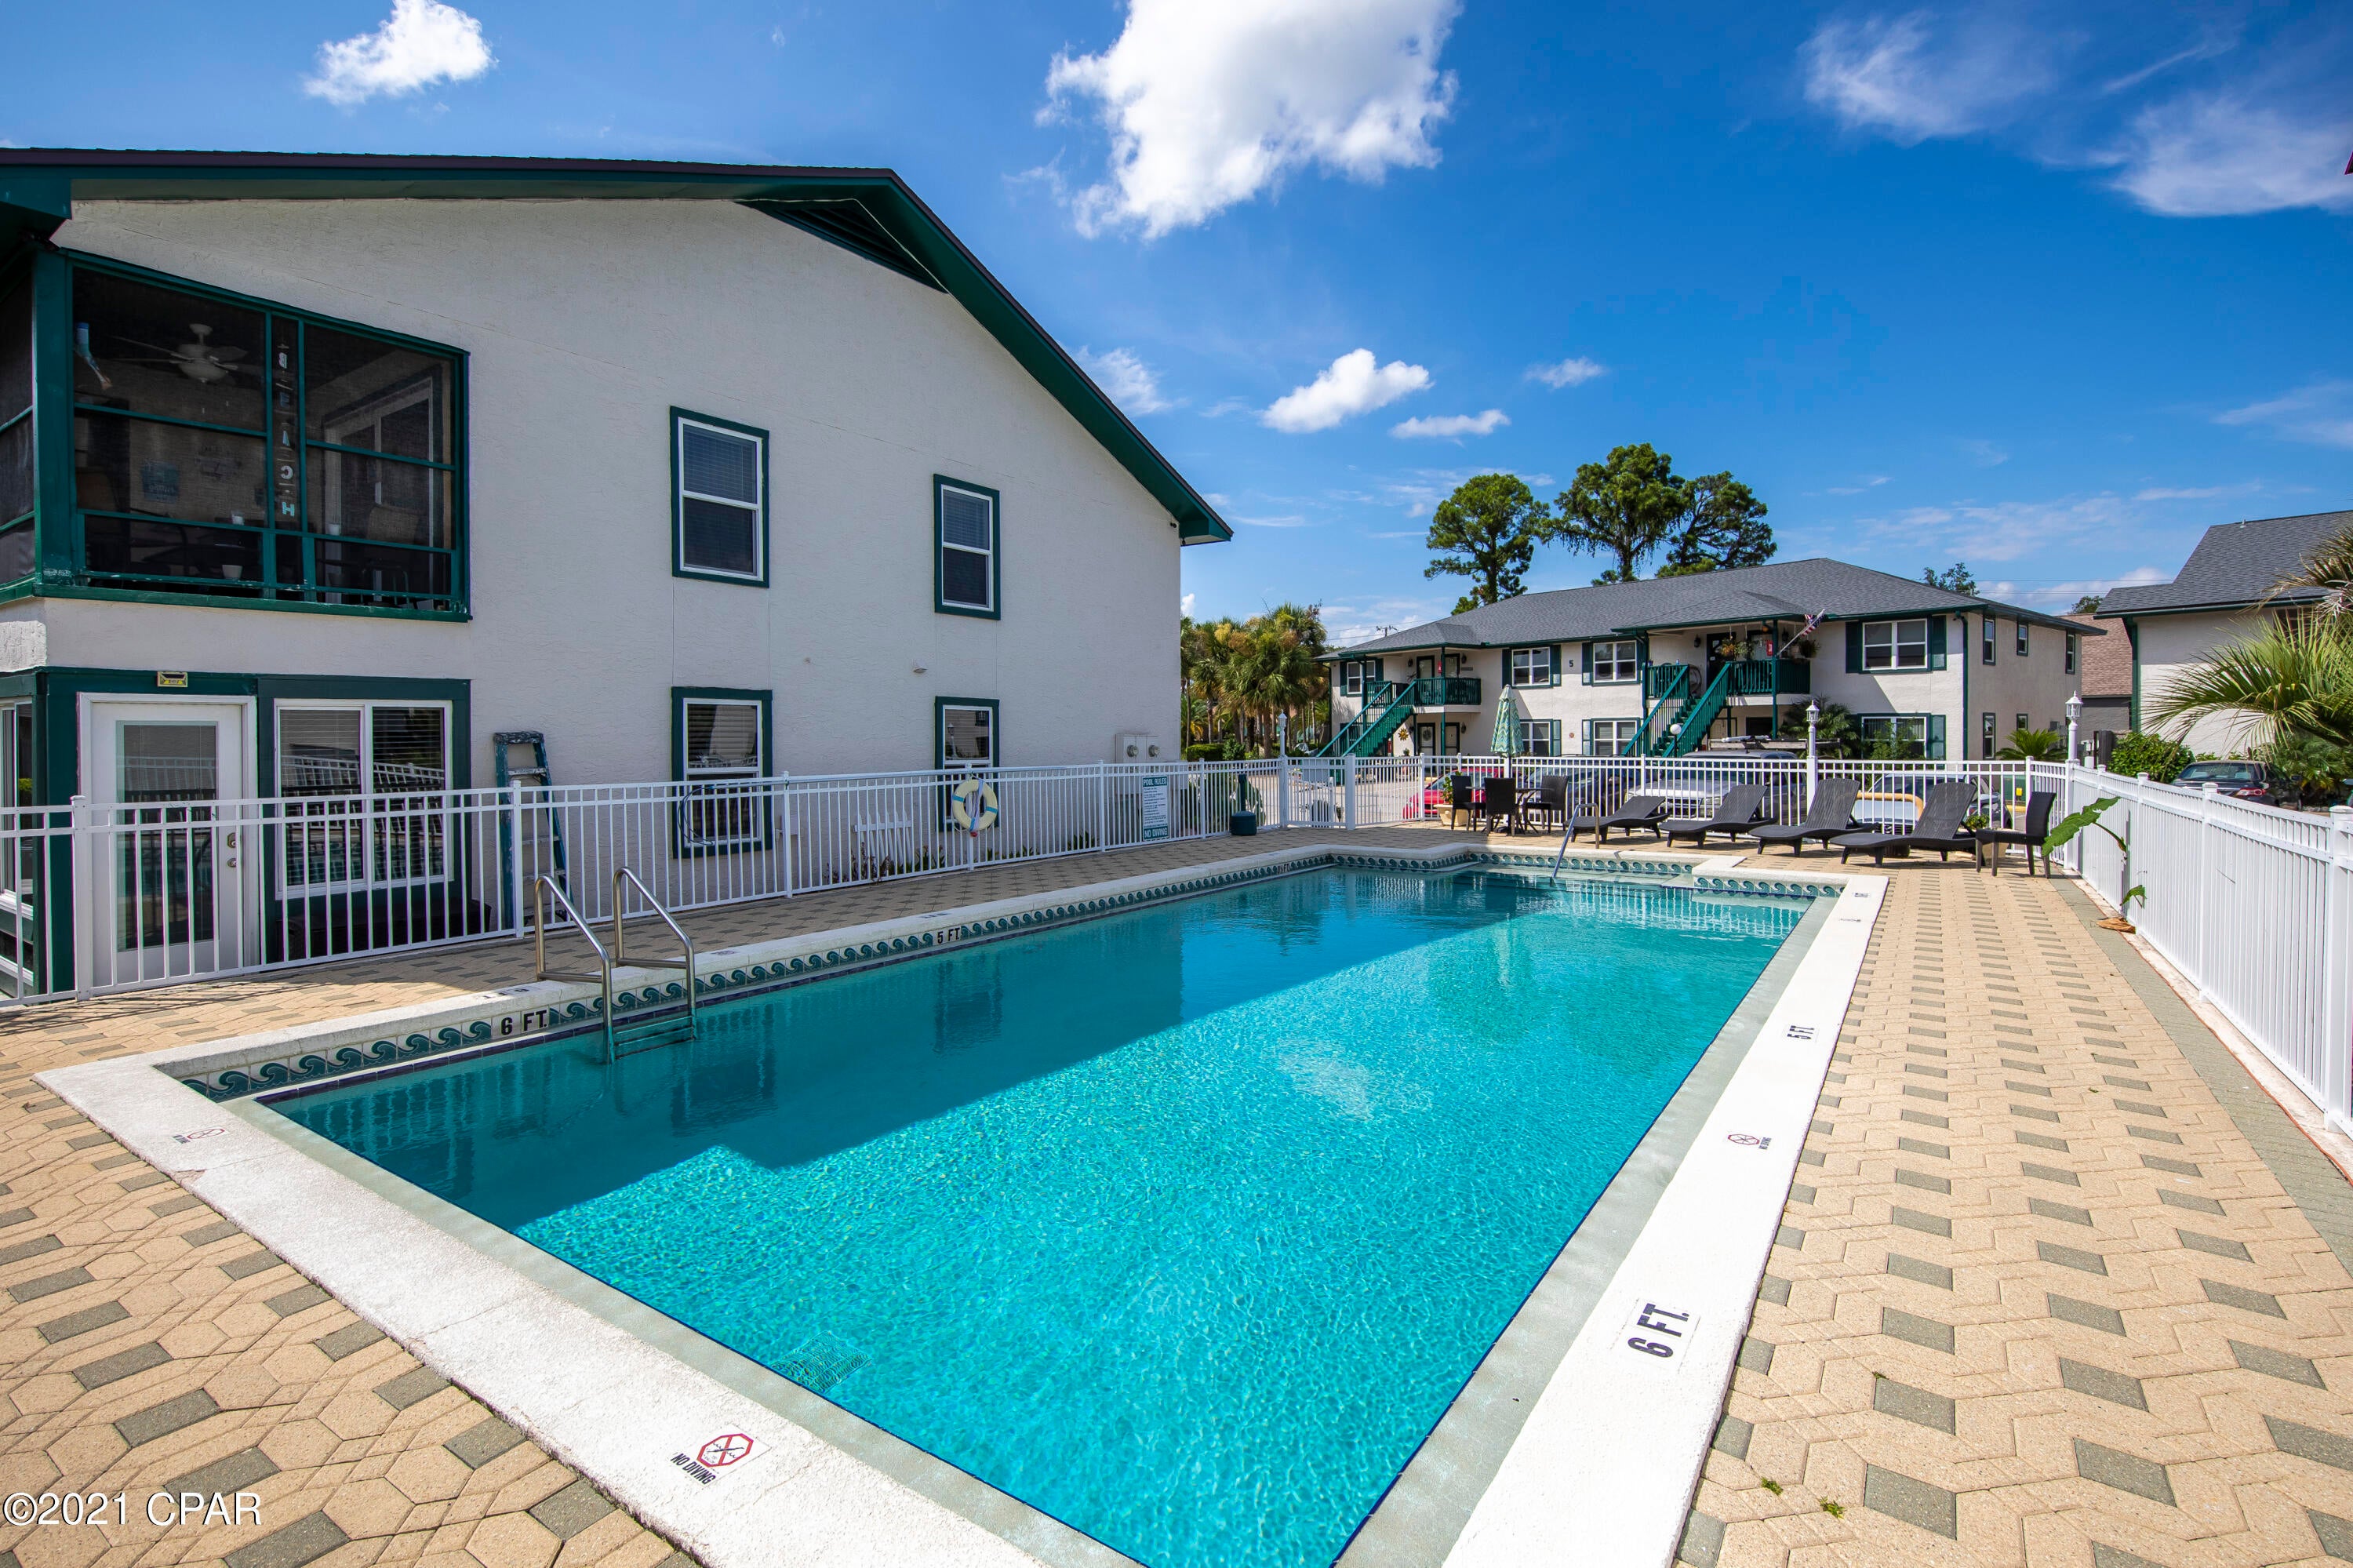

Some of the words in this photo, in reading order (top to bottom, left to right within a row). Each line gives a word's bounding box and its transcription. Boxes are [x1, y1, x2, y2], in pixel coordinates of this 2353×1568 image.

[1143, 778, 1154, 787] POOL
[1155, 777, 1167, 785] RULES
[1144, 829, 1151, 838] NO
[1152, 827, 1168, 837] DIVING
[937, 931, 944, 944] 5
[948, 927, 960, 941] FT.
[501, 1017, 513, 1035] 6
[523, 1010, 547, 1031] FT.
[1637, 1303, 1689, 1337] FT.
[1627, 1337, 1674, 1358] 6
[671, 1453, 690, 1467] NO
[682, 1461, 716, 1485] DIVING
